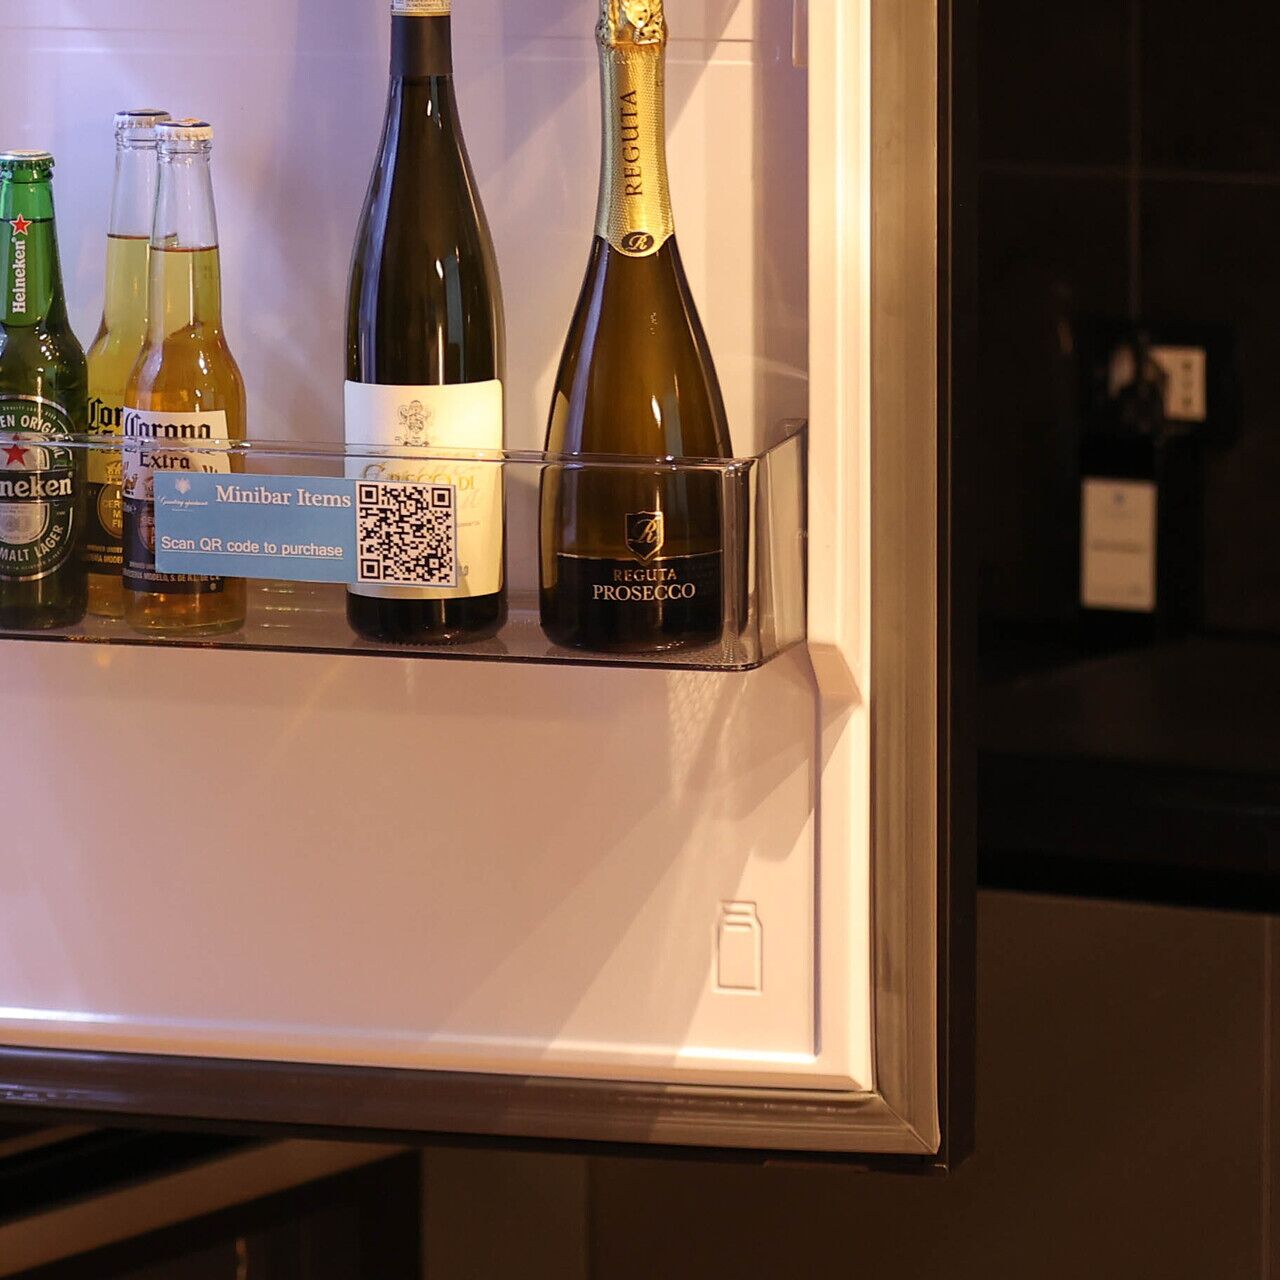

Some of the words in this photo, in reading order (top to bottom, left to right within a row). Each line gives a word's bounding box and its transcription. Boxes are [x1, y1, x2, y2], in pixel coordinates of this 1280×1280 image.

[620, 89, 643, 197] REGUTA
[12, 239, 26, 313] Heineken
[124, 411, 212, 440] Corona
[139, 451, 191, 470] Extra
[215, 484, 292, 506] Minibar
[296, 488, 352, 508] Items
[33, 523, 65, 558] LAGER
[161, 535, 195, 550] Scan
[200, 537, 222, 552] QR
[227, 540, 260, 553] code
[264, 541, 277, 554] to
[282, 542, 344, 558] purchase
[613, 568, 677, 582] REGUTA
[592, 582, 696, 601] PROSECCO
